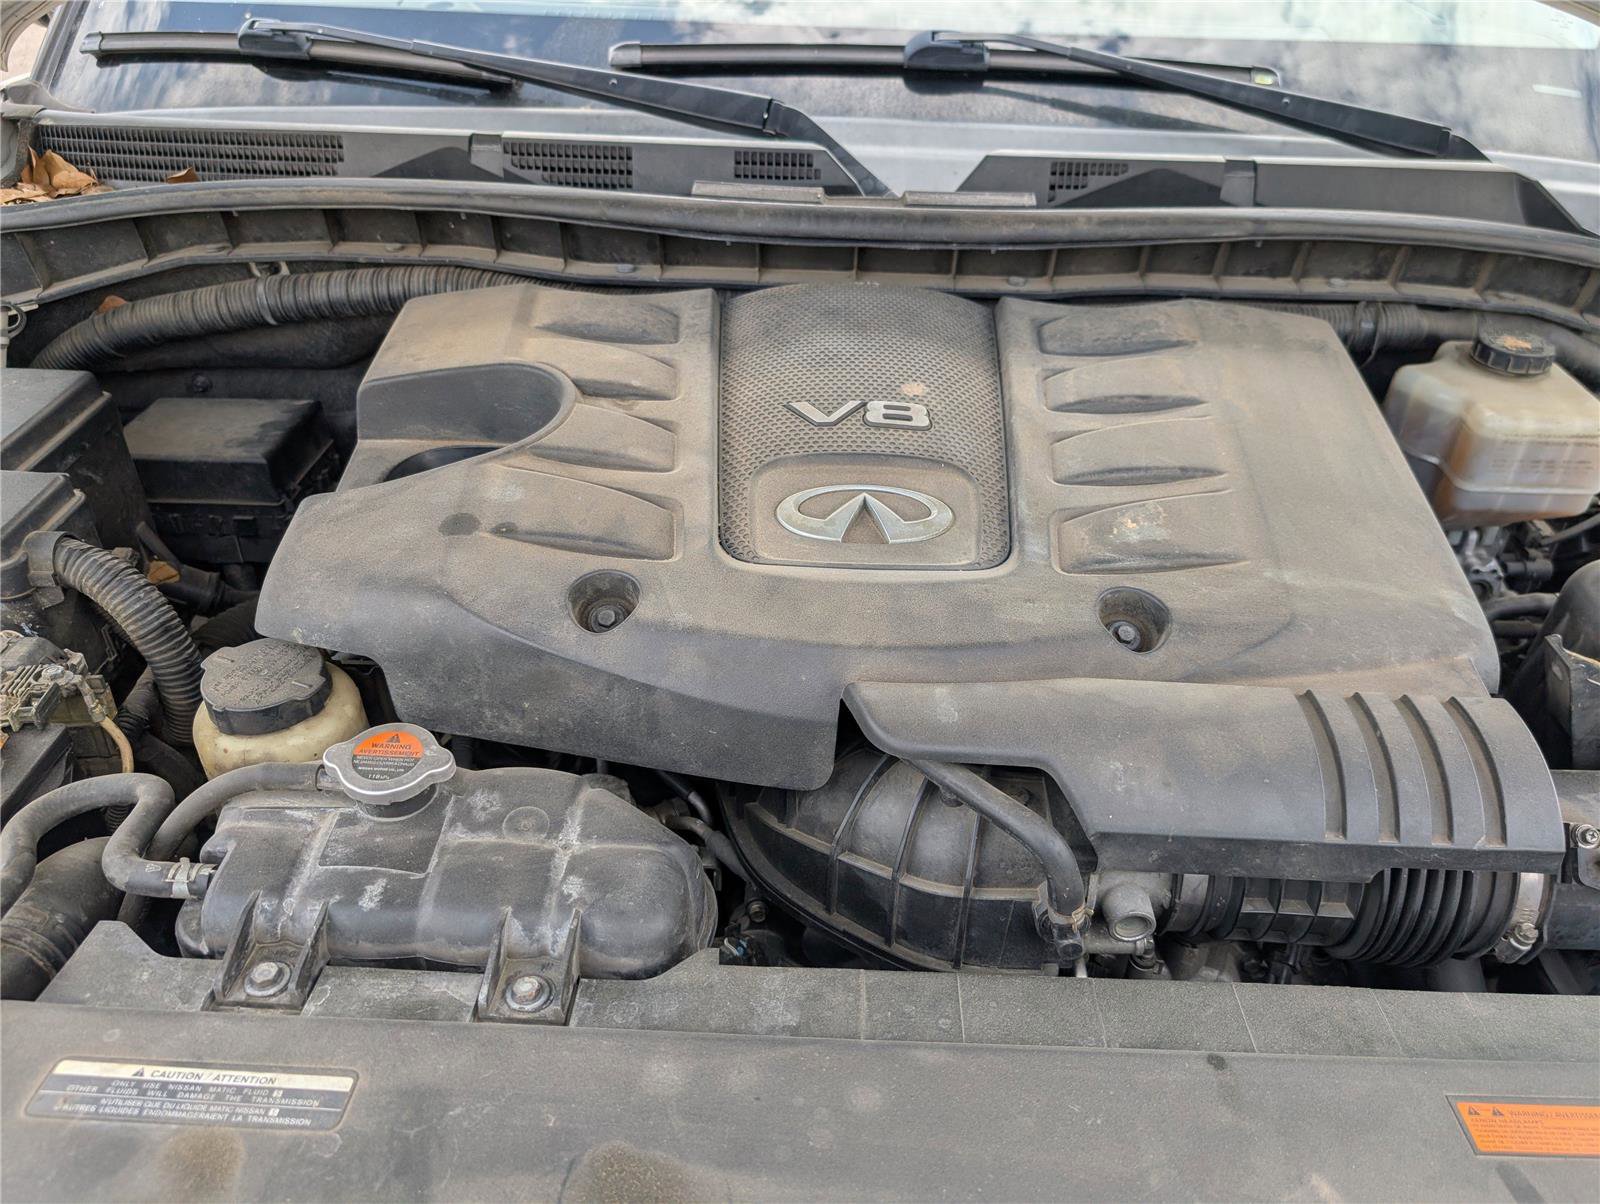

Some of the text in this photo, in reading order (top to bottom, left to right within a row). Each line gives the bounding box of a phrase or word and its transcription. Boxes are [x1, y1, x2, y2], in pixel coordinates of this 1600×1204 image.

[784, 399, 932, 431] V8
[358, 749, 420, 757] AVERTISSEMENT
[371, 742, 412, 750] WARNING
[150, 1069, 204, 1081] CAUTION
[212, 1073, 278, 1085] ATTENTION
[111, 1079, 137, 1088] ONLY
[143, 1082, 161, 1090] USE
[168, 1083, 202, 1092] NISSAN
[209, 1087, 237, 1095] MATIC
[243, 1088, 270, 1096] FLUID
[65, 1084, 321, 1108] OTHER FLUIDS WILL DAMAGE THE TRANSMISSION
[98, 1105, 140, 1115] LIQUIDES
[142, 1109, 228, 1121] ENDOMMAGERAIENT
[232, 1113, 243, 1122] LA
[247, 1115, 312, 1127] TRANSMISSION
[144, 1101, 163, 1109] QUE
[176, 1103, 208, 1111] LIQUIDE
[209, 1105, 235, 1113] MATIC
[235, 1106, 267, 1115] NISSAN
